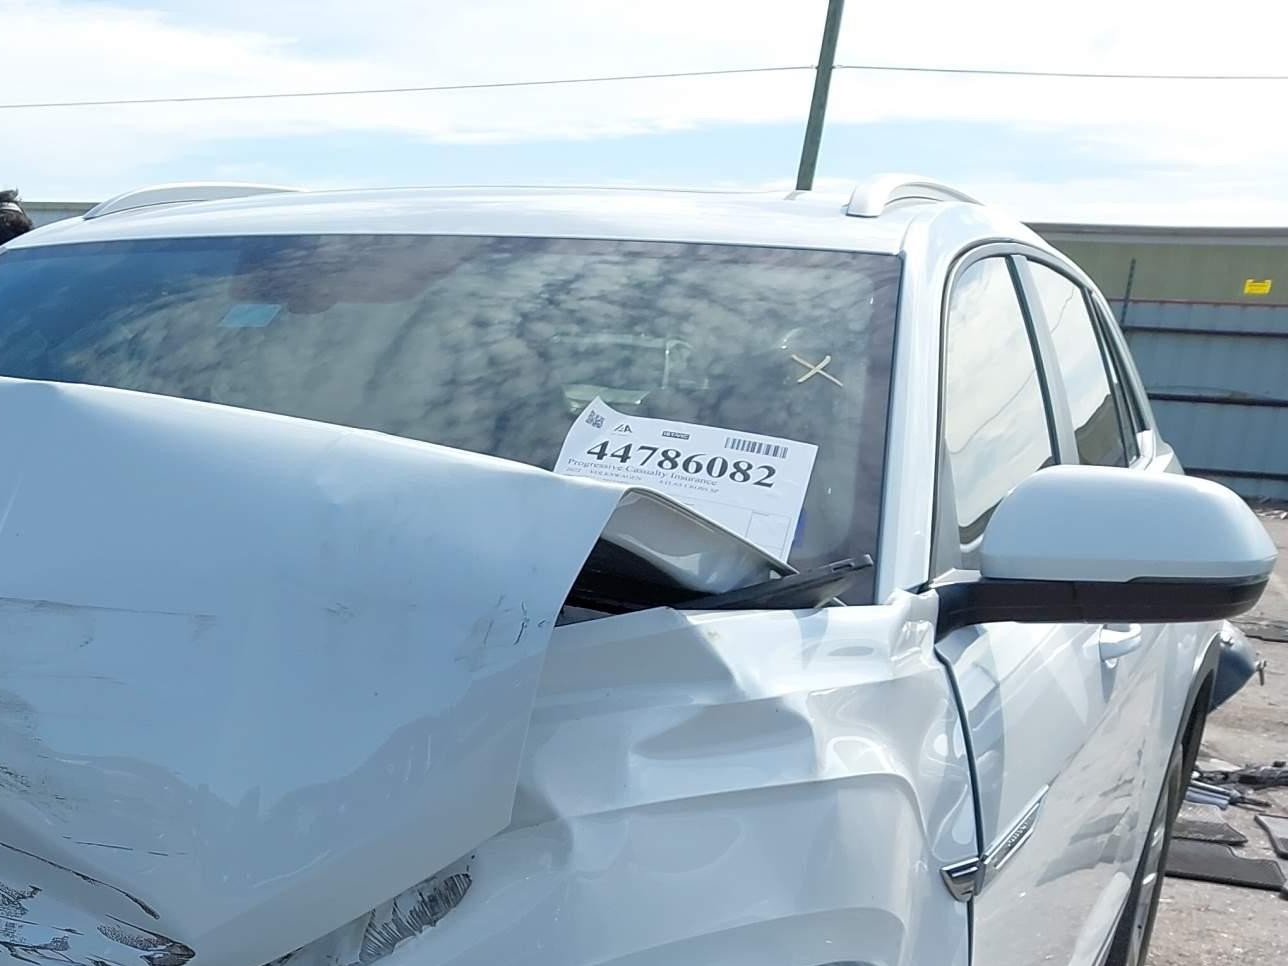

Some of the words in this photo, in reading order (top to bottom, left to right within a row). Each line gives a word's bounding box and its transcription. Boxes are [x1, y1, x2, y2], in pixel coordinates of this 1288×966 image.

[567, 458, 623, 471] Progressive
[625, 464, 666, 479] Casualty
[670, 471, 720, 486] Insurance
[586, 440, 776, 488] 44786082
